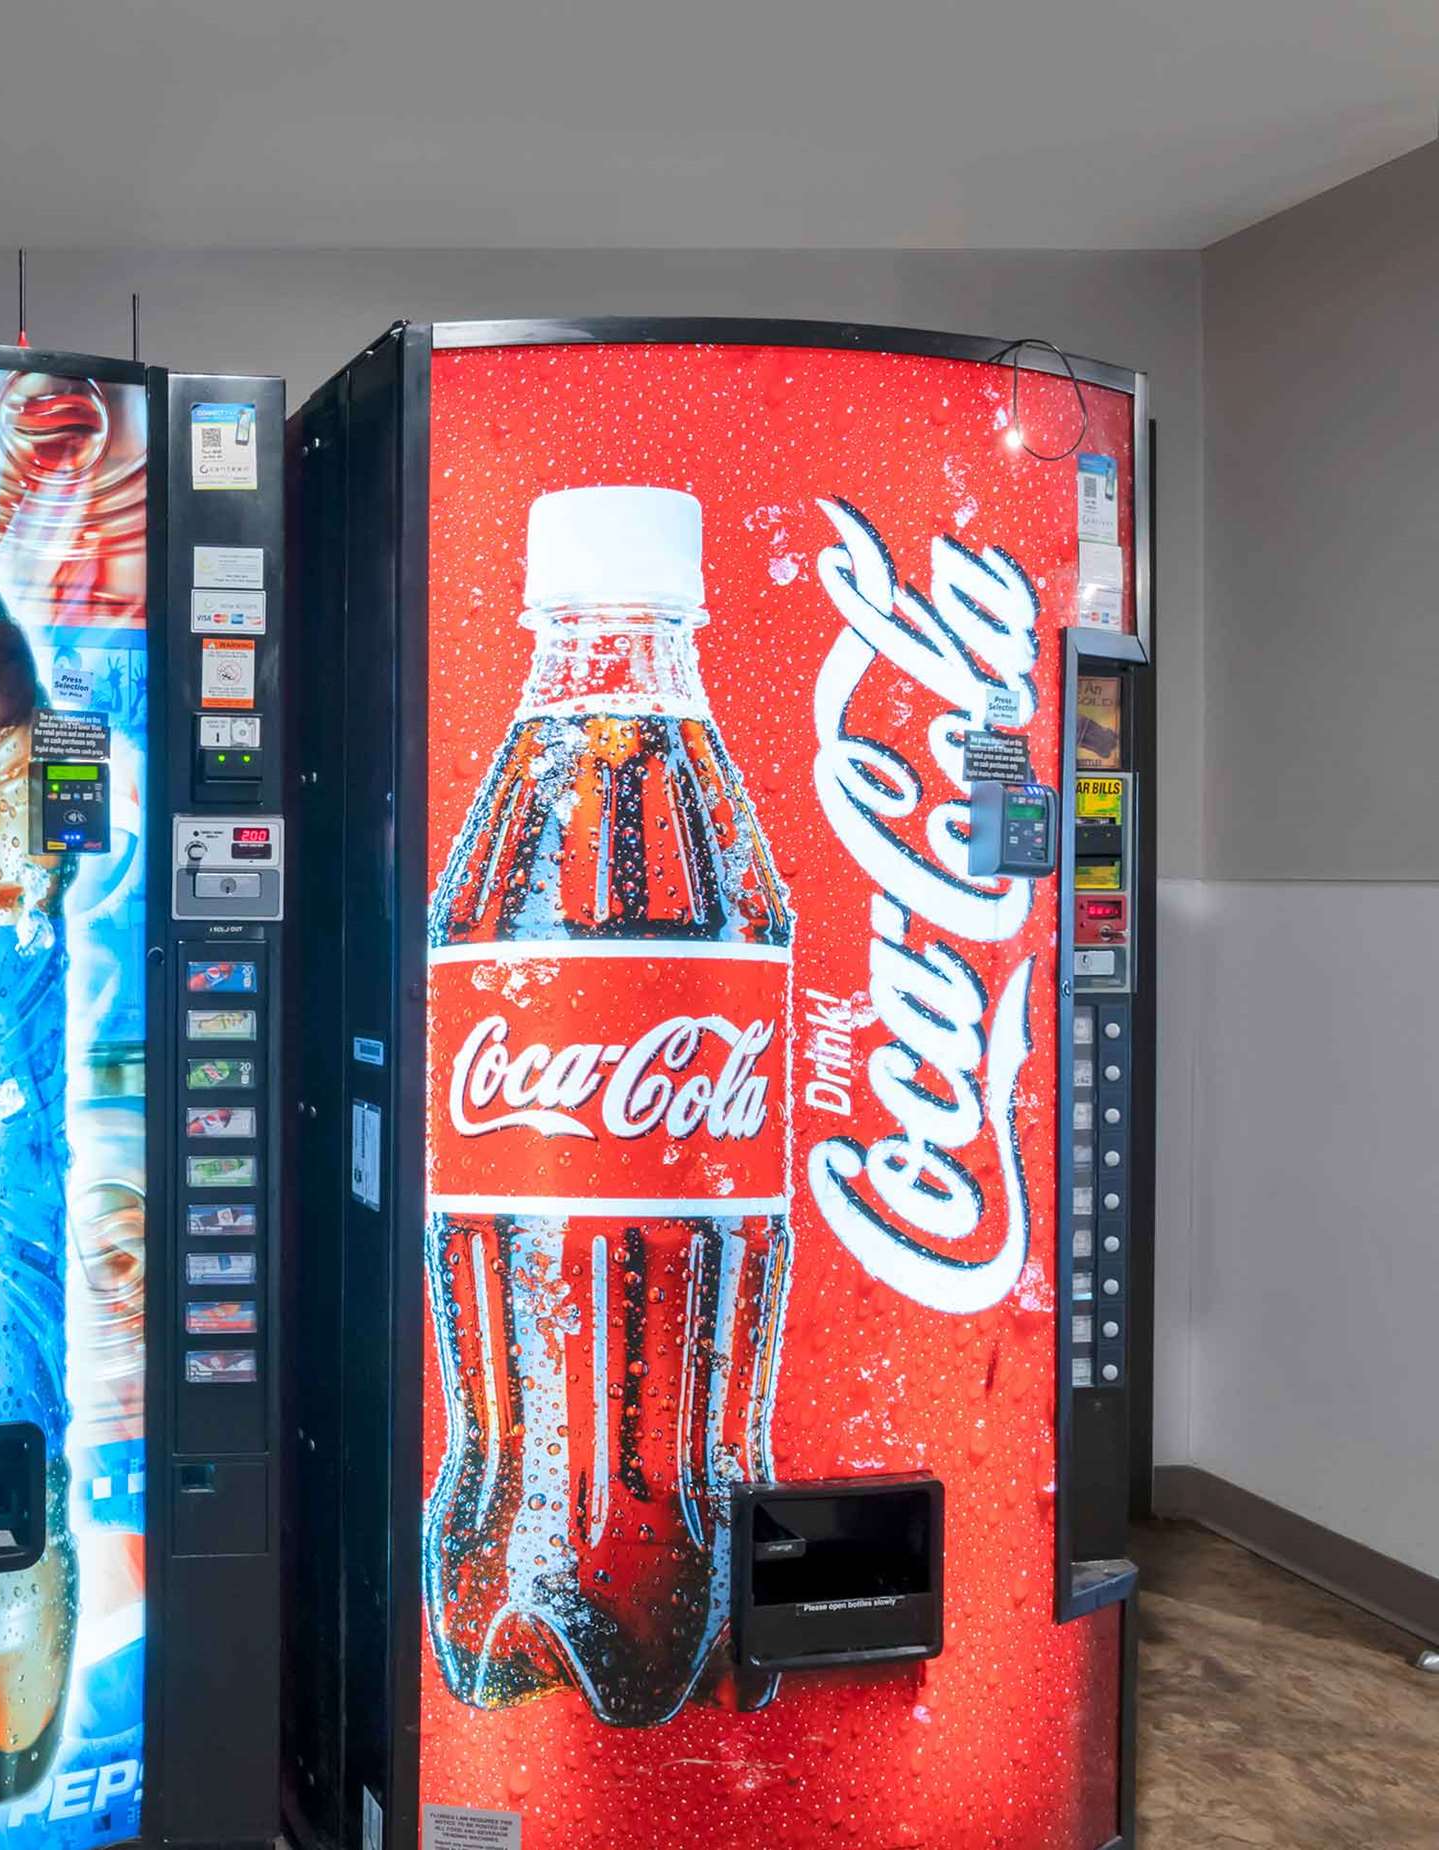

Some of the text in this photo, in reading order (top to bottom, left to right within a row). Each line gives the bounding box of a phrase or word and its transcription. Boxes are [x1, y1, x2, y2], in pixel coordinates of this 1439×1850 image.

[61, 674, 83, 684] Press
[54, 681, 89, 691] Selection
[994, 696, 1012, 704] Press
[988, 702, 1017, 712] Selection
[1092, 781, 1121, 794] BILLS
[804, 988, 851, 1117] Drink!
[449, 1015, 775, 1140] Coca-Cola
[768, 1543, 793, 1552] change
[803, 1597, 897, 1611] Please open bottles slowly
